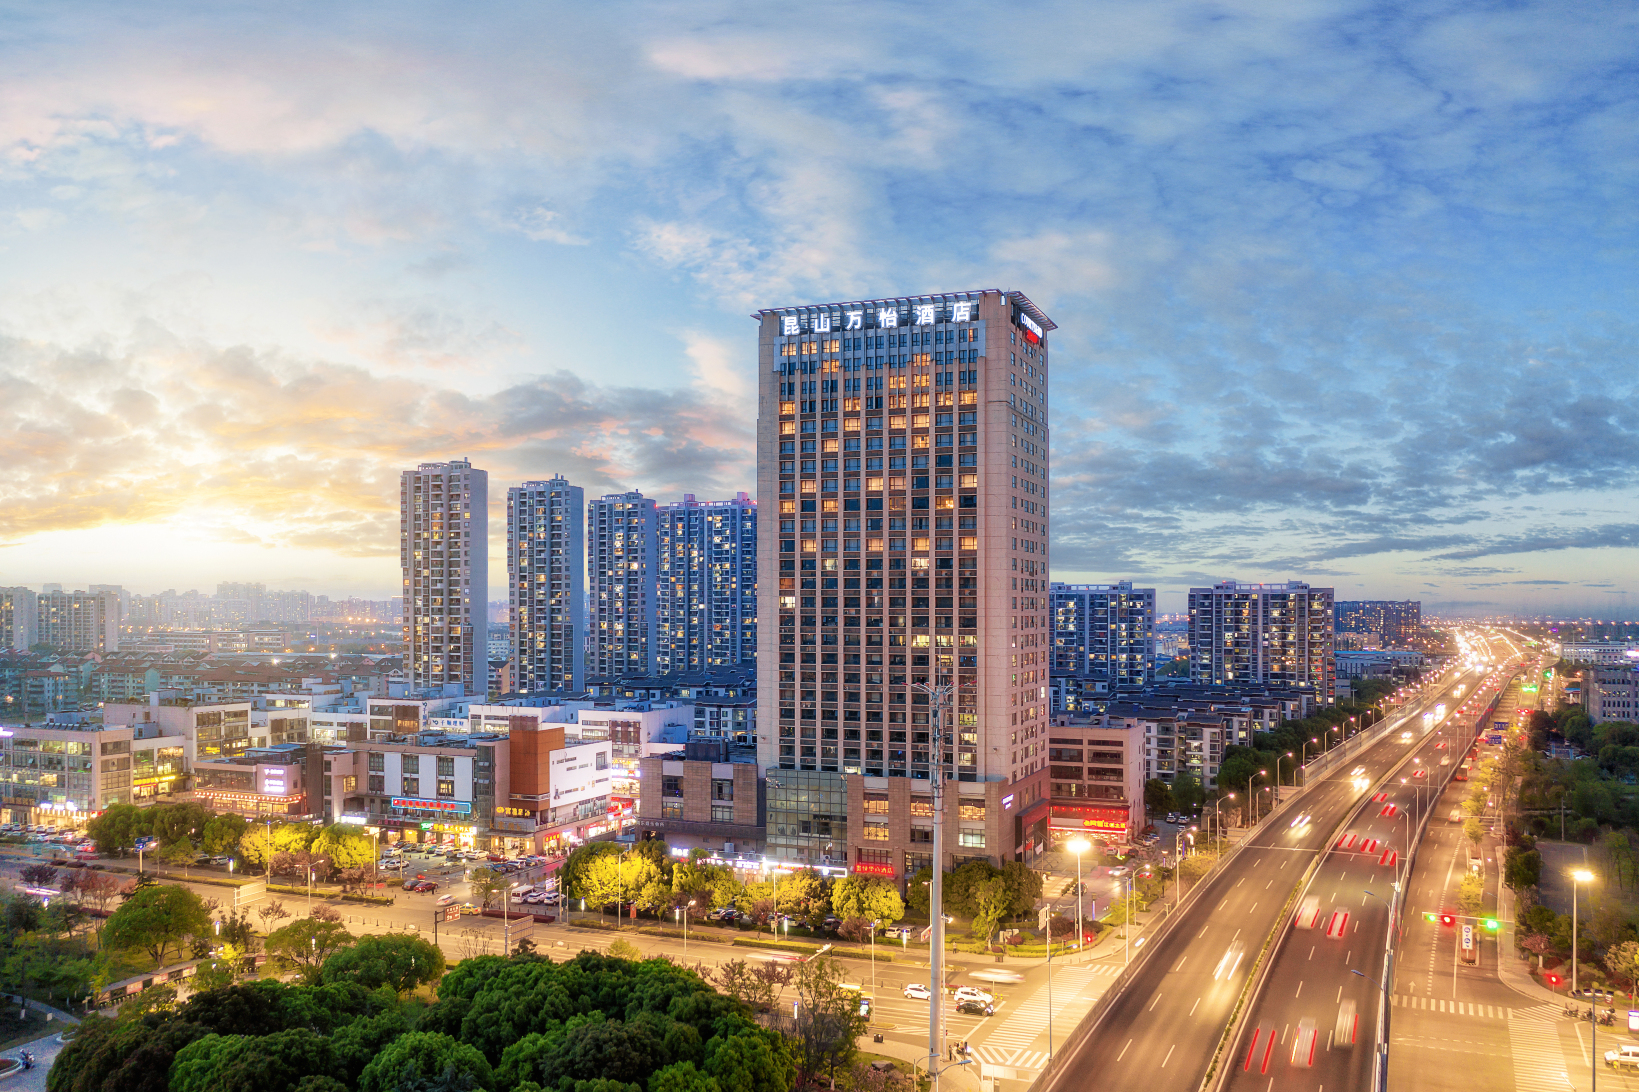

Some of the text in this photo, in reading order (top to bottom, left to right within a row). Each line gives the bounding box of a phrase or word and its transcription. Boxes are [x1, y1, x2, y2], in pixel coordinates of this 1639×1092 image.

[783, 301, 972, 336] 昆山万怡酒店
